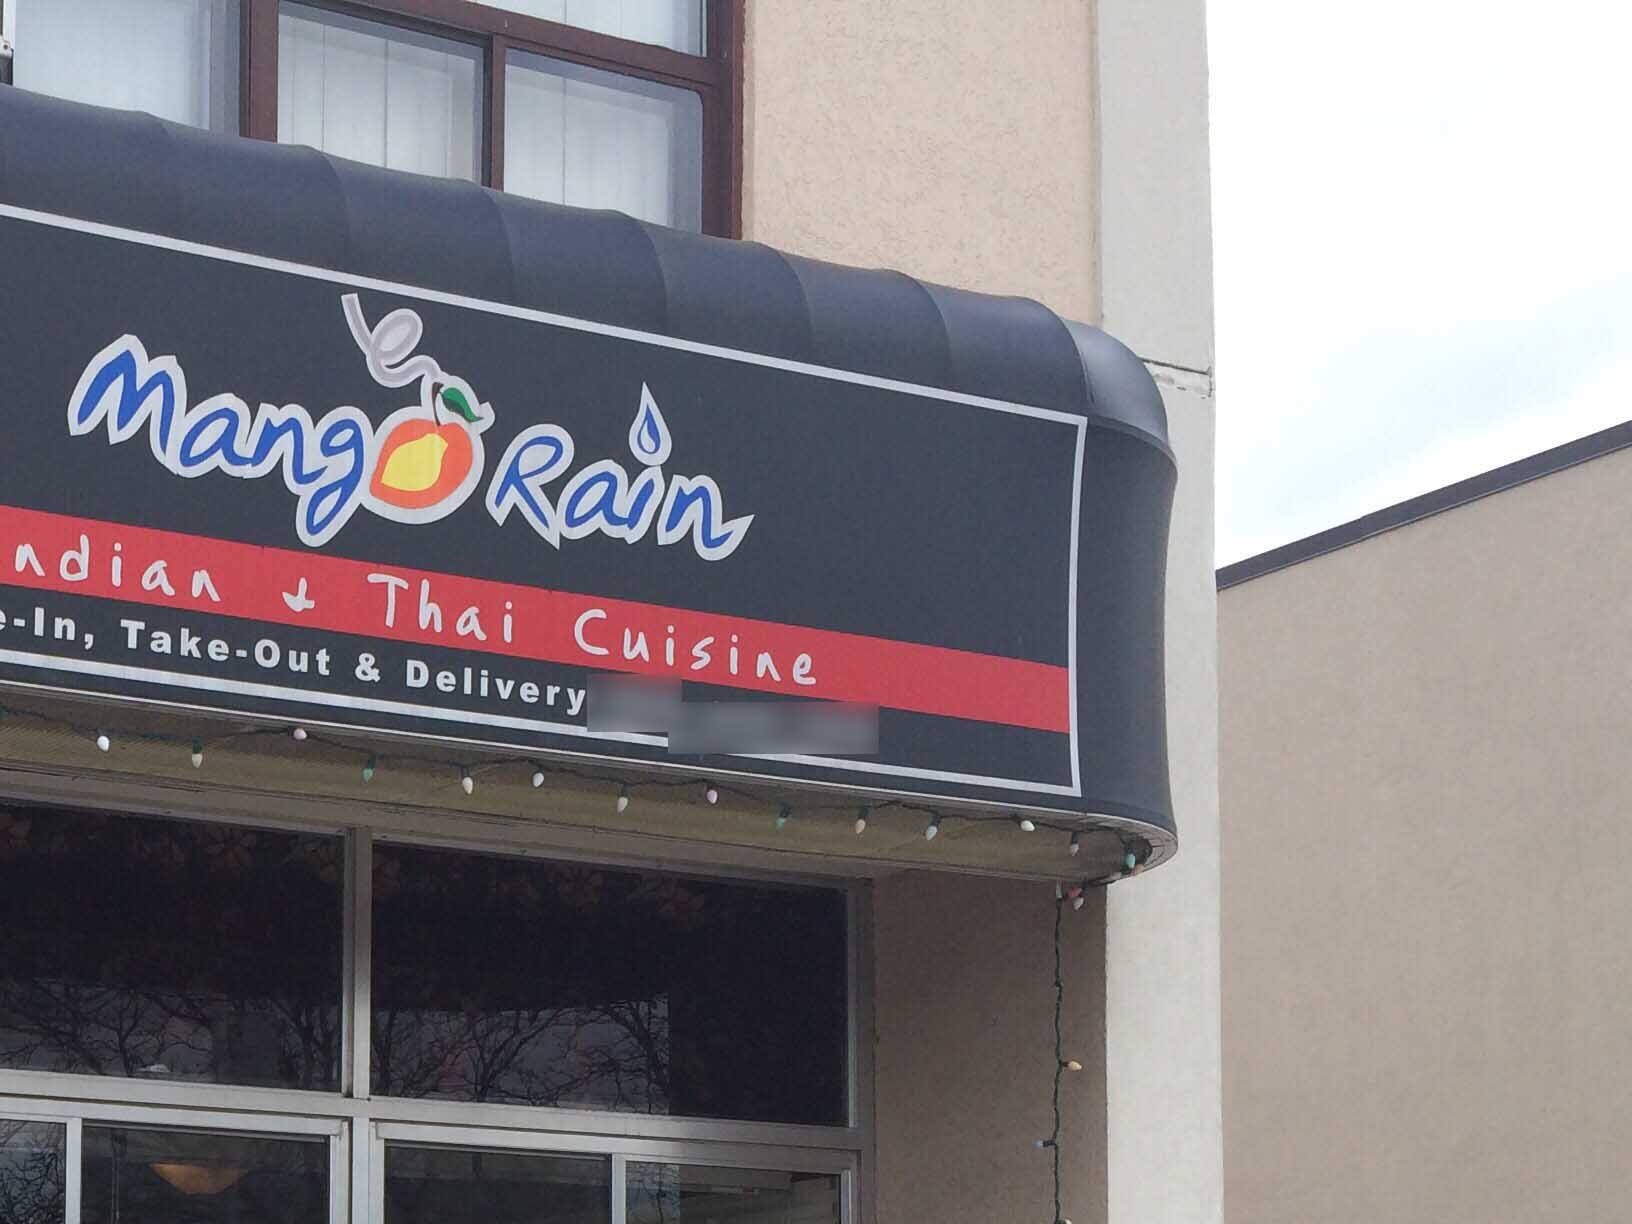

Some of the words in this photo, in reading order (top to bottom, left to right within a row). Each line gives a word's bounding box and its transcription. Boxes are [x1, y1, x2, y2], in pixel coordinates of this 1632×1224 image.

[485, 382, 754, 561] Rain
[120, 619, 331, 678] Take-Out
[354, 652, 382, 683] &
[405, 659, 587, 716] Delivery
[367, 572, 513, 643] Thai
[573, 608, 817, 686] Cuisine
